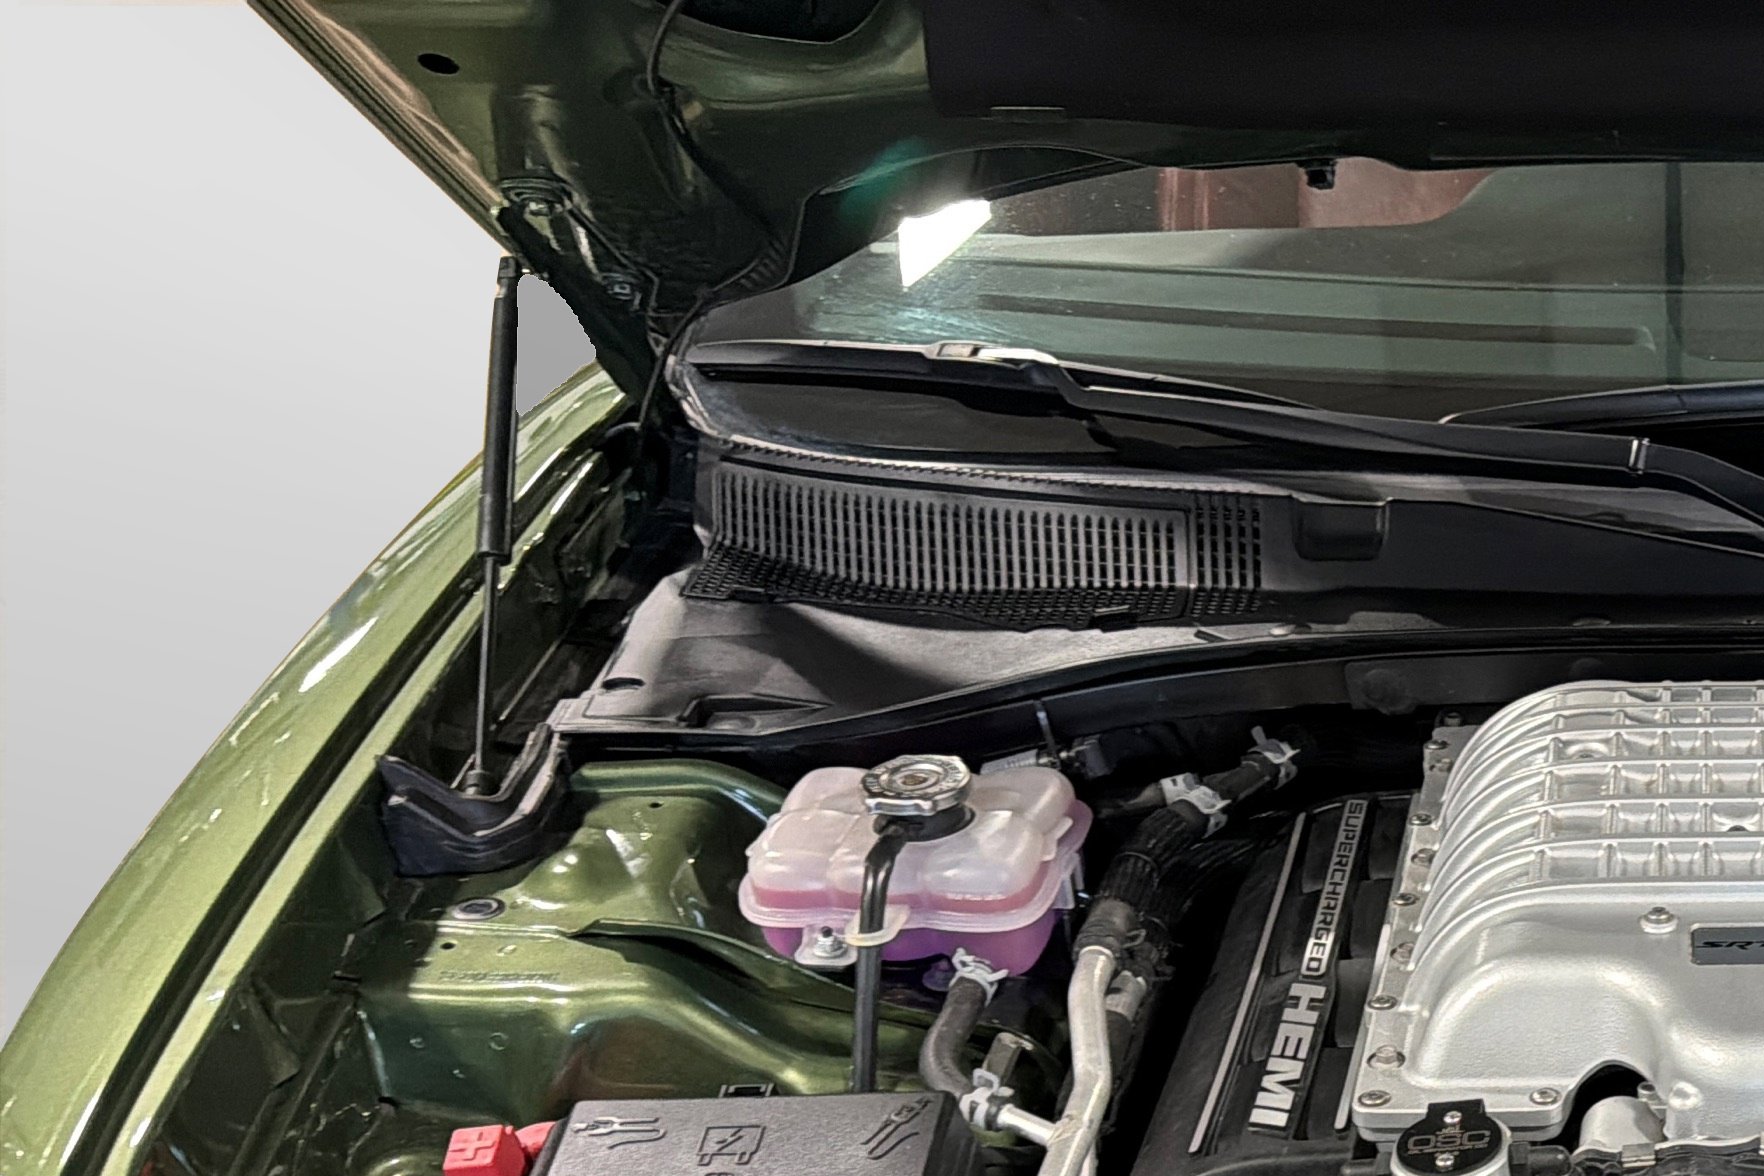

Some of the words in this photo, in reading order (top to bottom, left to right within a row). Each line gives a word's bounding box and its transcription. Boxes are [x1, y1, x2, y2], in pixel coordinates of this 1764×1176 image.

[1303, 800, 1368, 975] SUPERCHARGED
[1249, 982, 1328, 1129] HEMI
[1407, 1130, 1491, 1150] OSC
